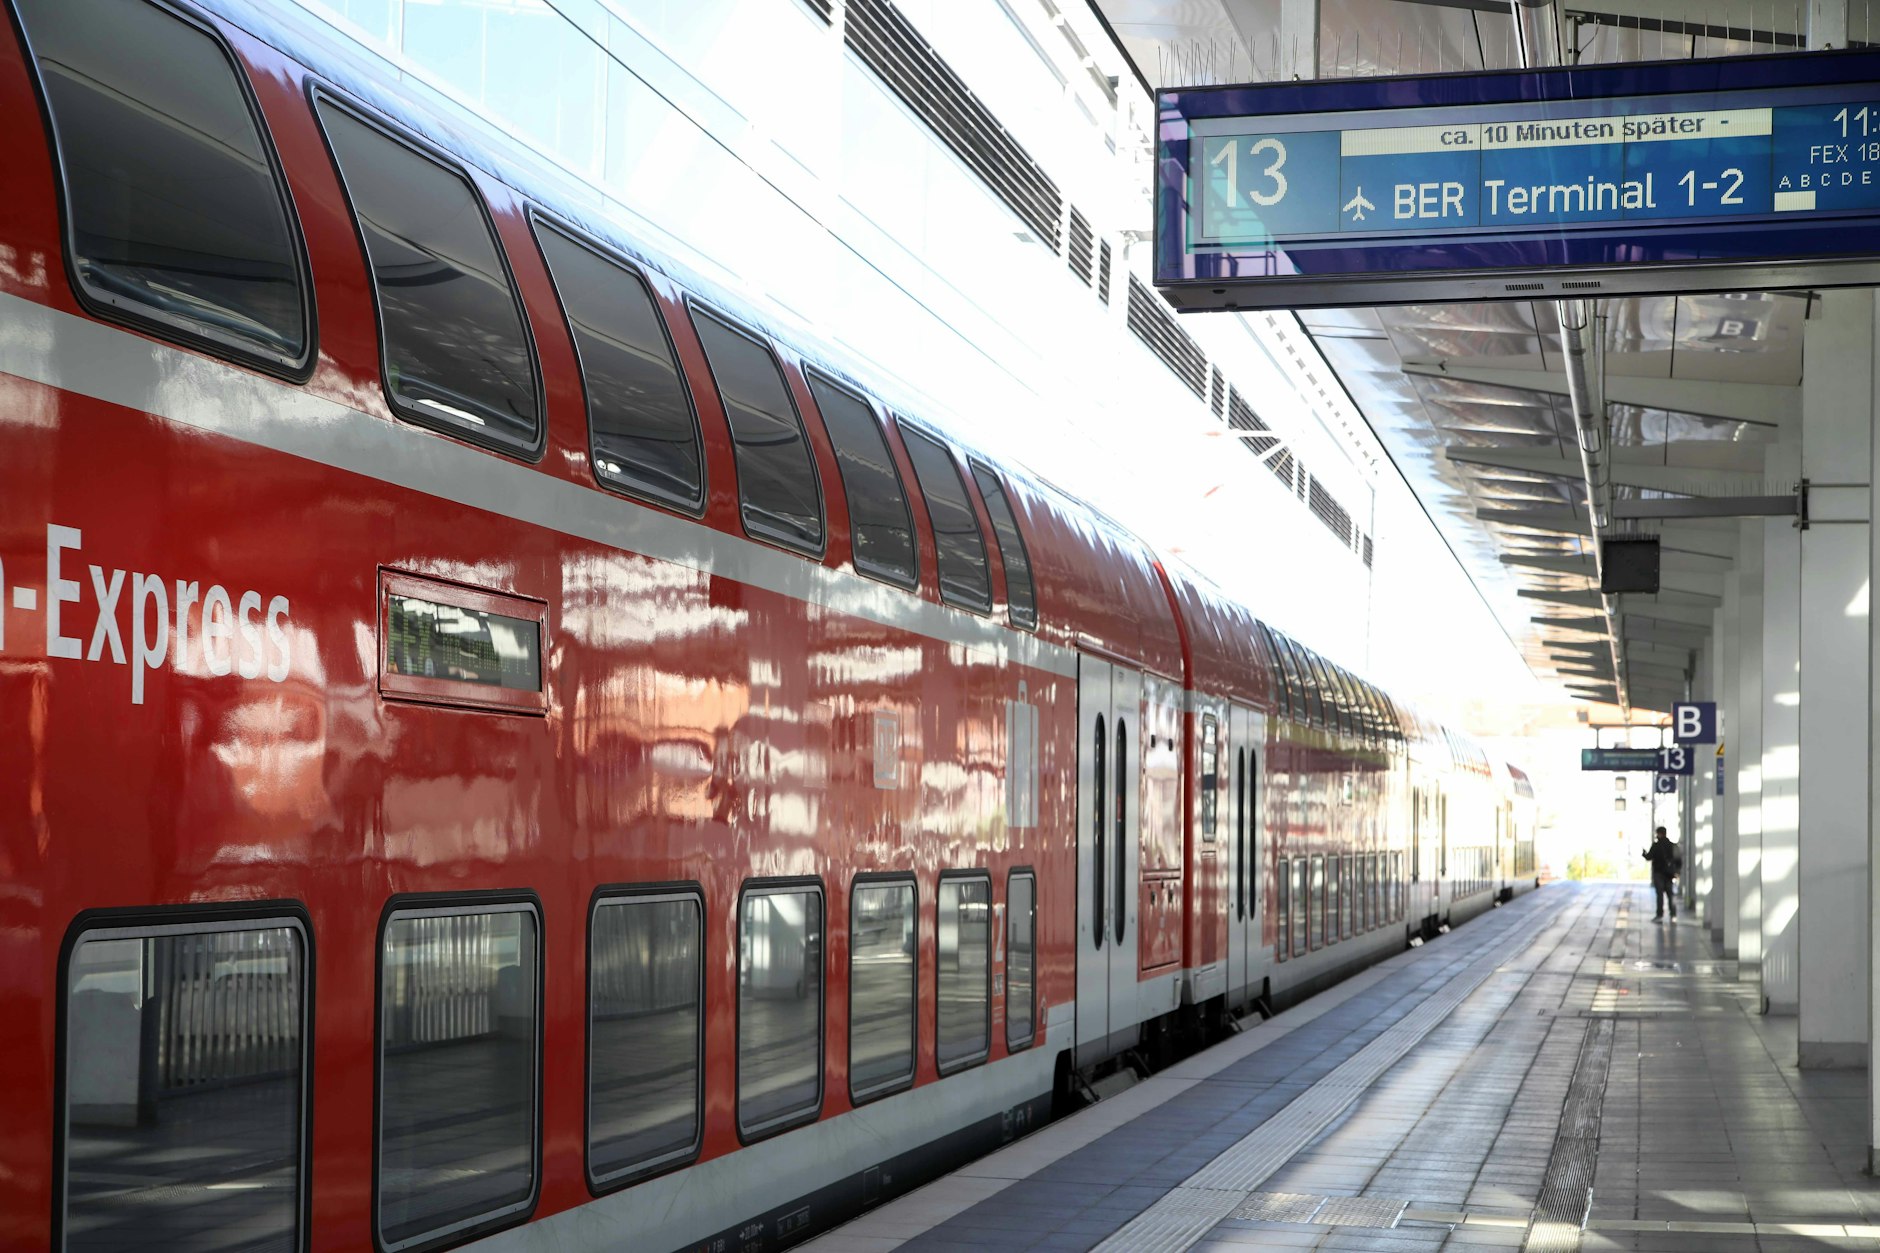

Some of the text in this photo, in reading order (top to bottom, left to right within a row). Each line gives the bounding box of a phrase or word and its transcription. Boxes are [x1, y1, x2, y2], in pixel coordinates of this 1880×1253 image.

[1440, 129, 1474, 146] ca.
[1484, 125, 1509, 144] 10
[1516, 121, 1614, 142] Minuten
[1622, 116, 1706, 140] später
[1833, 106, 1880, 138] 11:
[1810, 142, 1880, 164] FEX 18
[1210, 138, 1288, 208] 13
[1779, 171, 1872, 188] A B C D E
[1393, 168, 1745, 219] BER Terminal 1-2
[0, 523, 290, 704] -Express
[1678, 706, 1702, 738] B
[1659, 749, 1685, 769] 13
[1658, 777, 1670, 792] C
